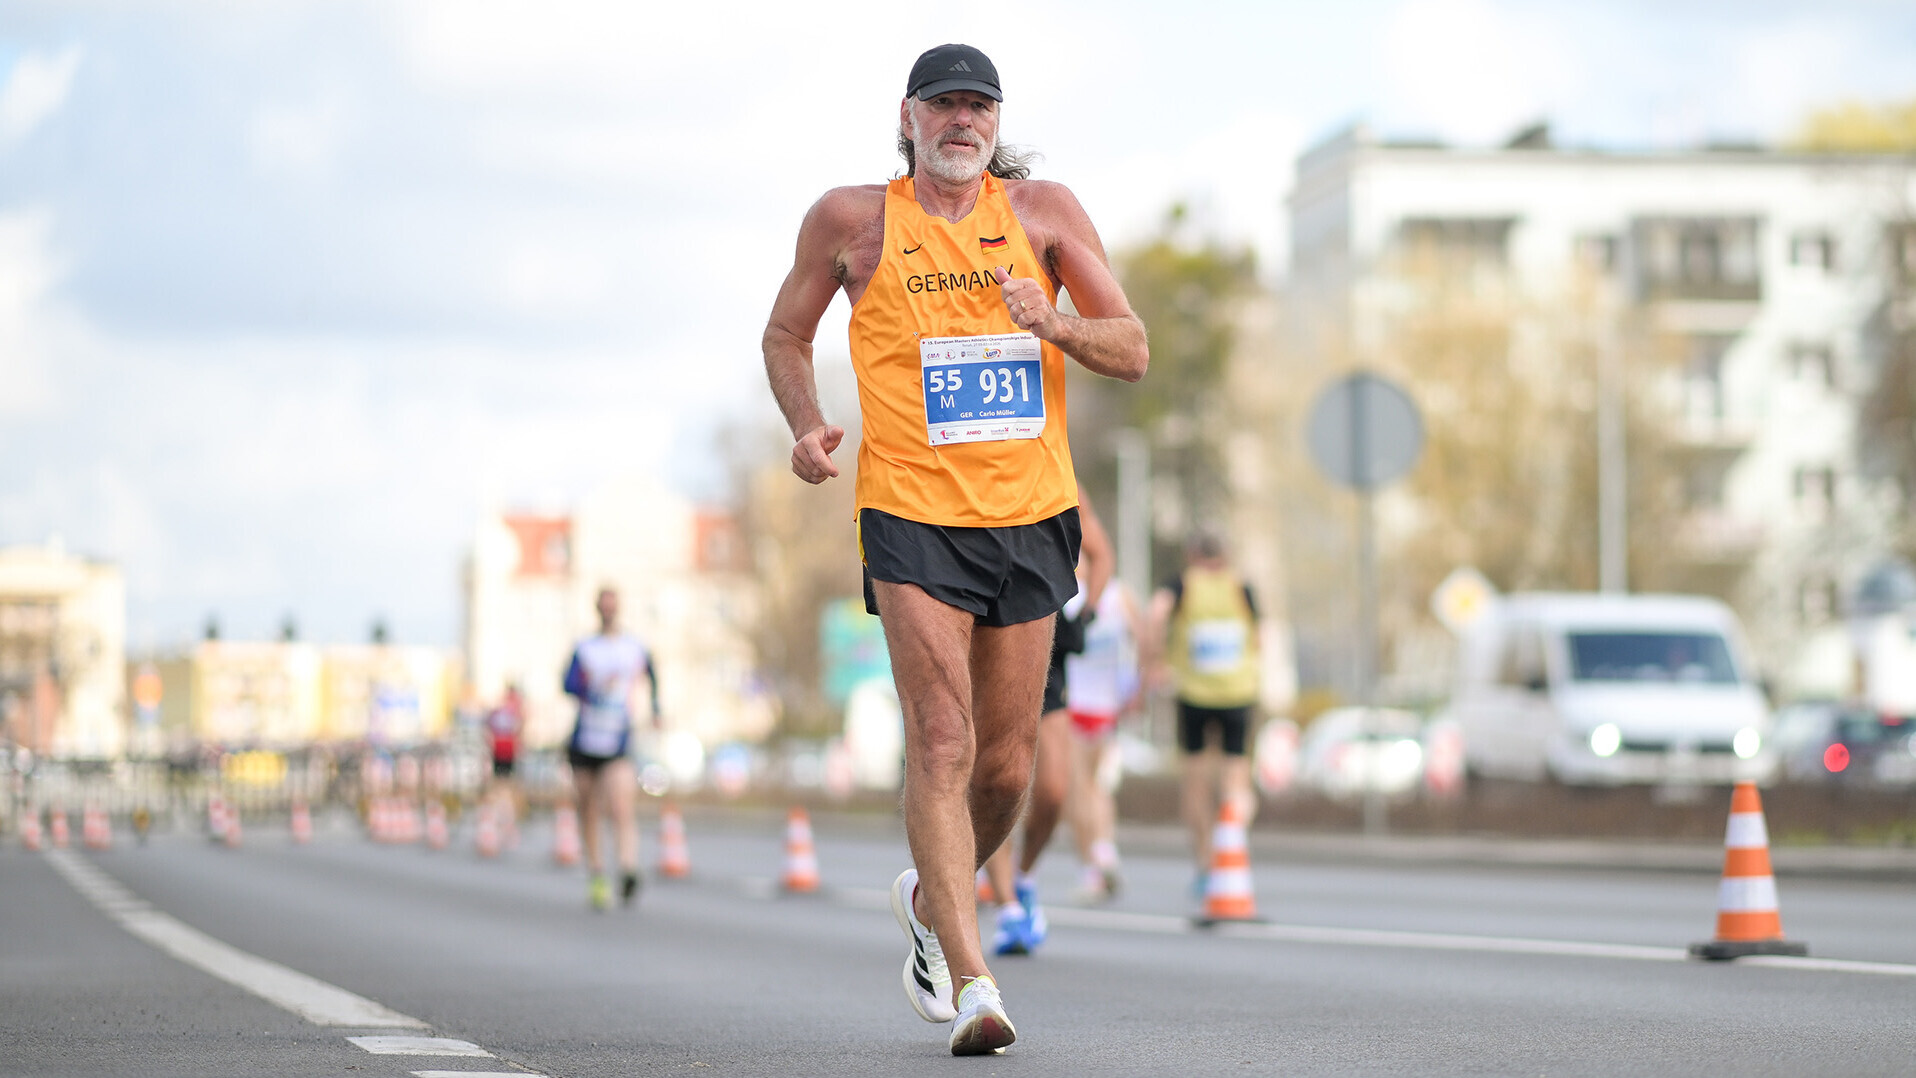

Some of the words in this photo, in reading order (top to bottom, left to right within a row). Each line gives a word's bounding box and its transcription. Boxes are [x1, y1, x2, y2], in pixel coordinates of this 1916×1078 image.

[930, 369, 963, 393] 55
[979, 367, 1029, 404] 931
[940, 394, 955, 409] M
